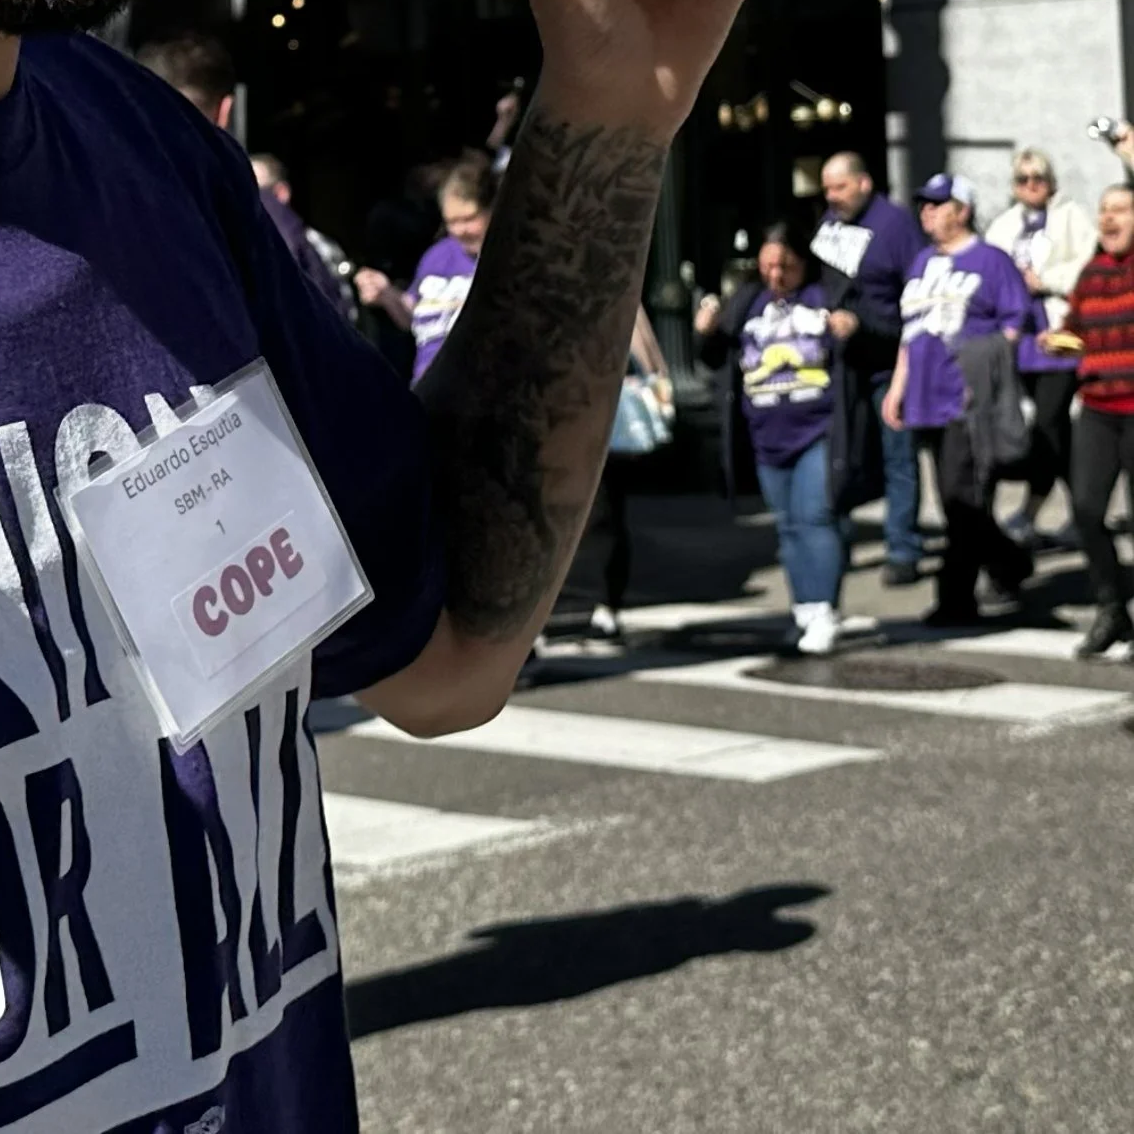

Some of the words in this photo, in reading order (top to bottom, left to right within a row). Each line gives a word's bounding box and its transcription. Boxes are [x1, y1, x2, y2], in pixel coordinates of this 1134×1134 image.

[121, 449, 191, 500] Eduardo
[189, 409, 243, 457] Esqutia
[214, 520, 227, 535] 1
[192, 527, 304, 637] COPE
[160, 687, 327, 1061] ALL
